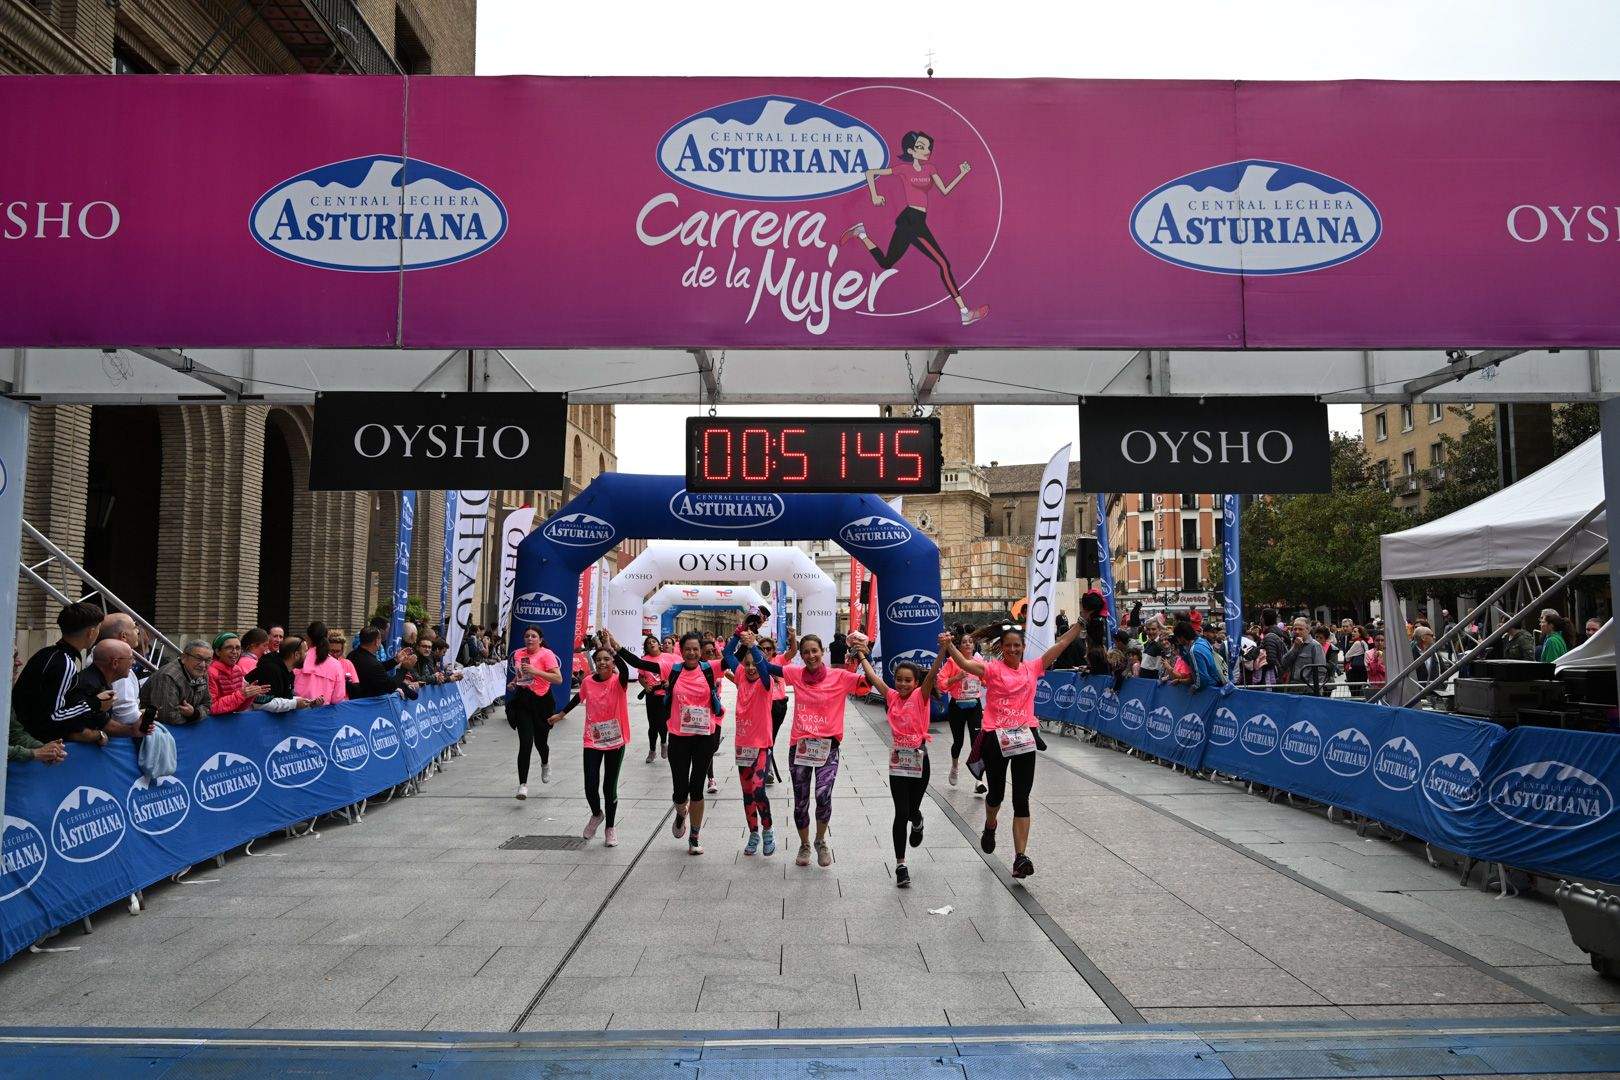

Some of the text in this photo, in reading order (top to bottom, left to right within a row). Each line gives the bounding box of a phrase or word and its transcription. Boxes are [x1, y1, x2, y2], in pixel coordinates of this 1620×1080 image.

[711, 132, 864, 143] CENTRAL LECHERA
[675, 133, 870, 174] ASTURIANA
[311, 196, 480, 207] CENTRAL LECHERA
[1188, 200, 1354, 210] CENTRAL LECHERA
[0, 201, 120, 240] SHO
[269, 198, 488, 242] ASTURIANA
[636, 193, 826, 249] Carrera
[1149, 202, 1363, 244] ASTURIANA
[682, 243, 898, 336] de la Mujer
[354, 423, 530, 460] OYSHO
[1120, 430, 1294, 464] OYSHO
[679, 495, 776, 517] ASTURIANA
[547, 524, 609, 539] ASTURIANA
[846, 529, 907, 541] ASTURIANA
[679, 553, 768, 571] OYSHO
[1031, 478, 1064, 627] OYSHO
[515, 603, 562, 616] ASTURIANA
[890, 607, 939, 619] ASTURIANA
[1242, 726, 1275, 747] ASTURIANA
[1283, 734, 1317, 756] ASTURIANA
[336, 744, 368, 763] ASTURIANA
[1326, 742, 1367, 768] ASTURIANA
[272, 757, 324, 780] ASTURIANA
[200, 777, 258, 802] ASTURIANA
[1494, 781, 1600, 817] ASTURIANA
[132, 795, 186, 824] ASTURIANA
[59, 812, 123, 852] ASTURIANA
